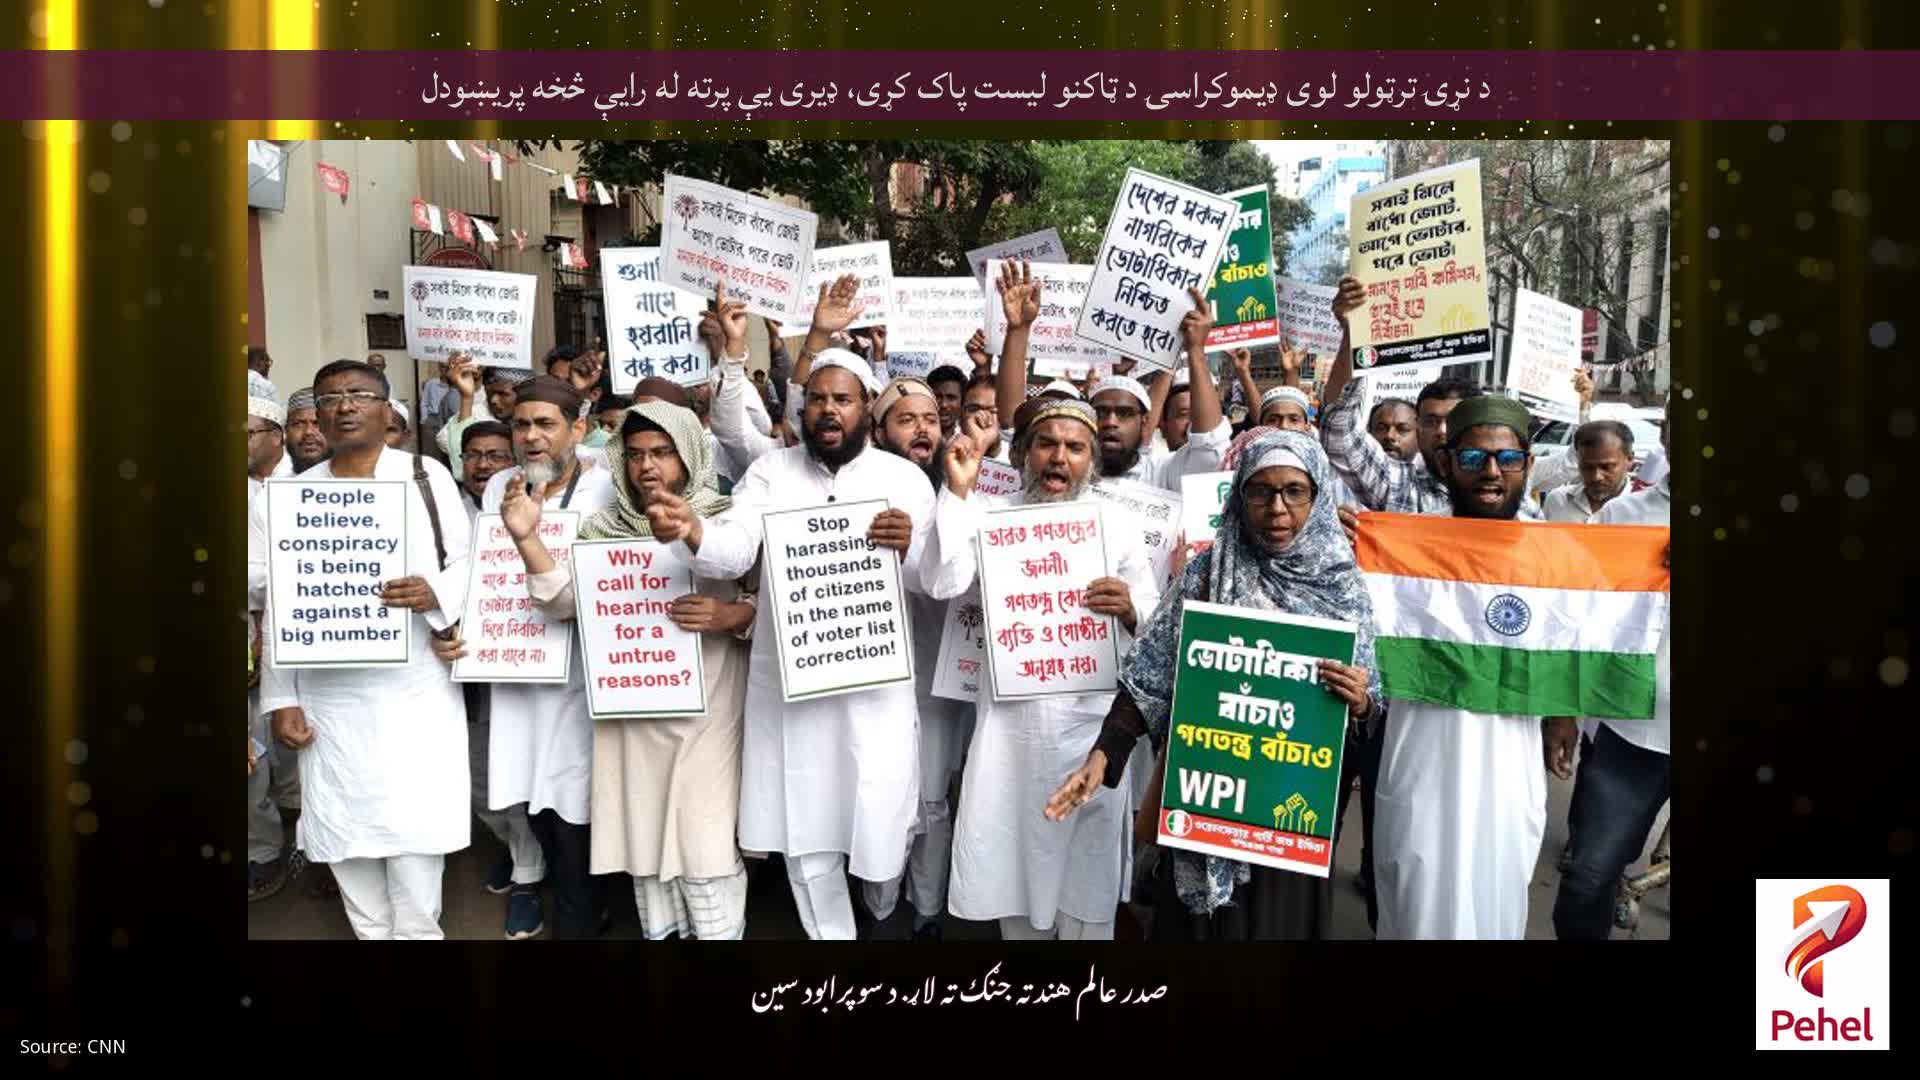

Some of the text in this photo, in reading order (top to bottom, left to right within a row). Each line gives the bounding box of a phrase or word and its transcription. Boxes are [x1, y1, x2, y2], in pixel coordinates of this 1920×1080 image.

[301, 488, 376, 508] People
[296, 512, 380, 529] believe,
[807, 517, 850, 532] Stop
[278, 537, 398, 554] conspiracy
[297, 559, 381, 577] is being
[607, 550, 653, 569] Why
[786, 555, 882, 581] thousands
[597, 573, 672, 592] call for
[789, 579, 885, 603] of citizens
[292, 604, 389, 623] against a
[787, 599, 893, 626] in the name
[281, 626, 401, 645] big number
[615, 623, 664, 640] for a
[791, 618, 896, 648] of voter list
[608, 648, 676, 665] untrue
[795, 640, 897, 669] correction!
[597, 669, 692, 691] reasons?
[1218, 682, 1295, 730] বাঁচাও
[1179, 767, 1247, 814] WPI
